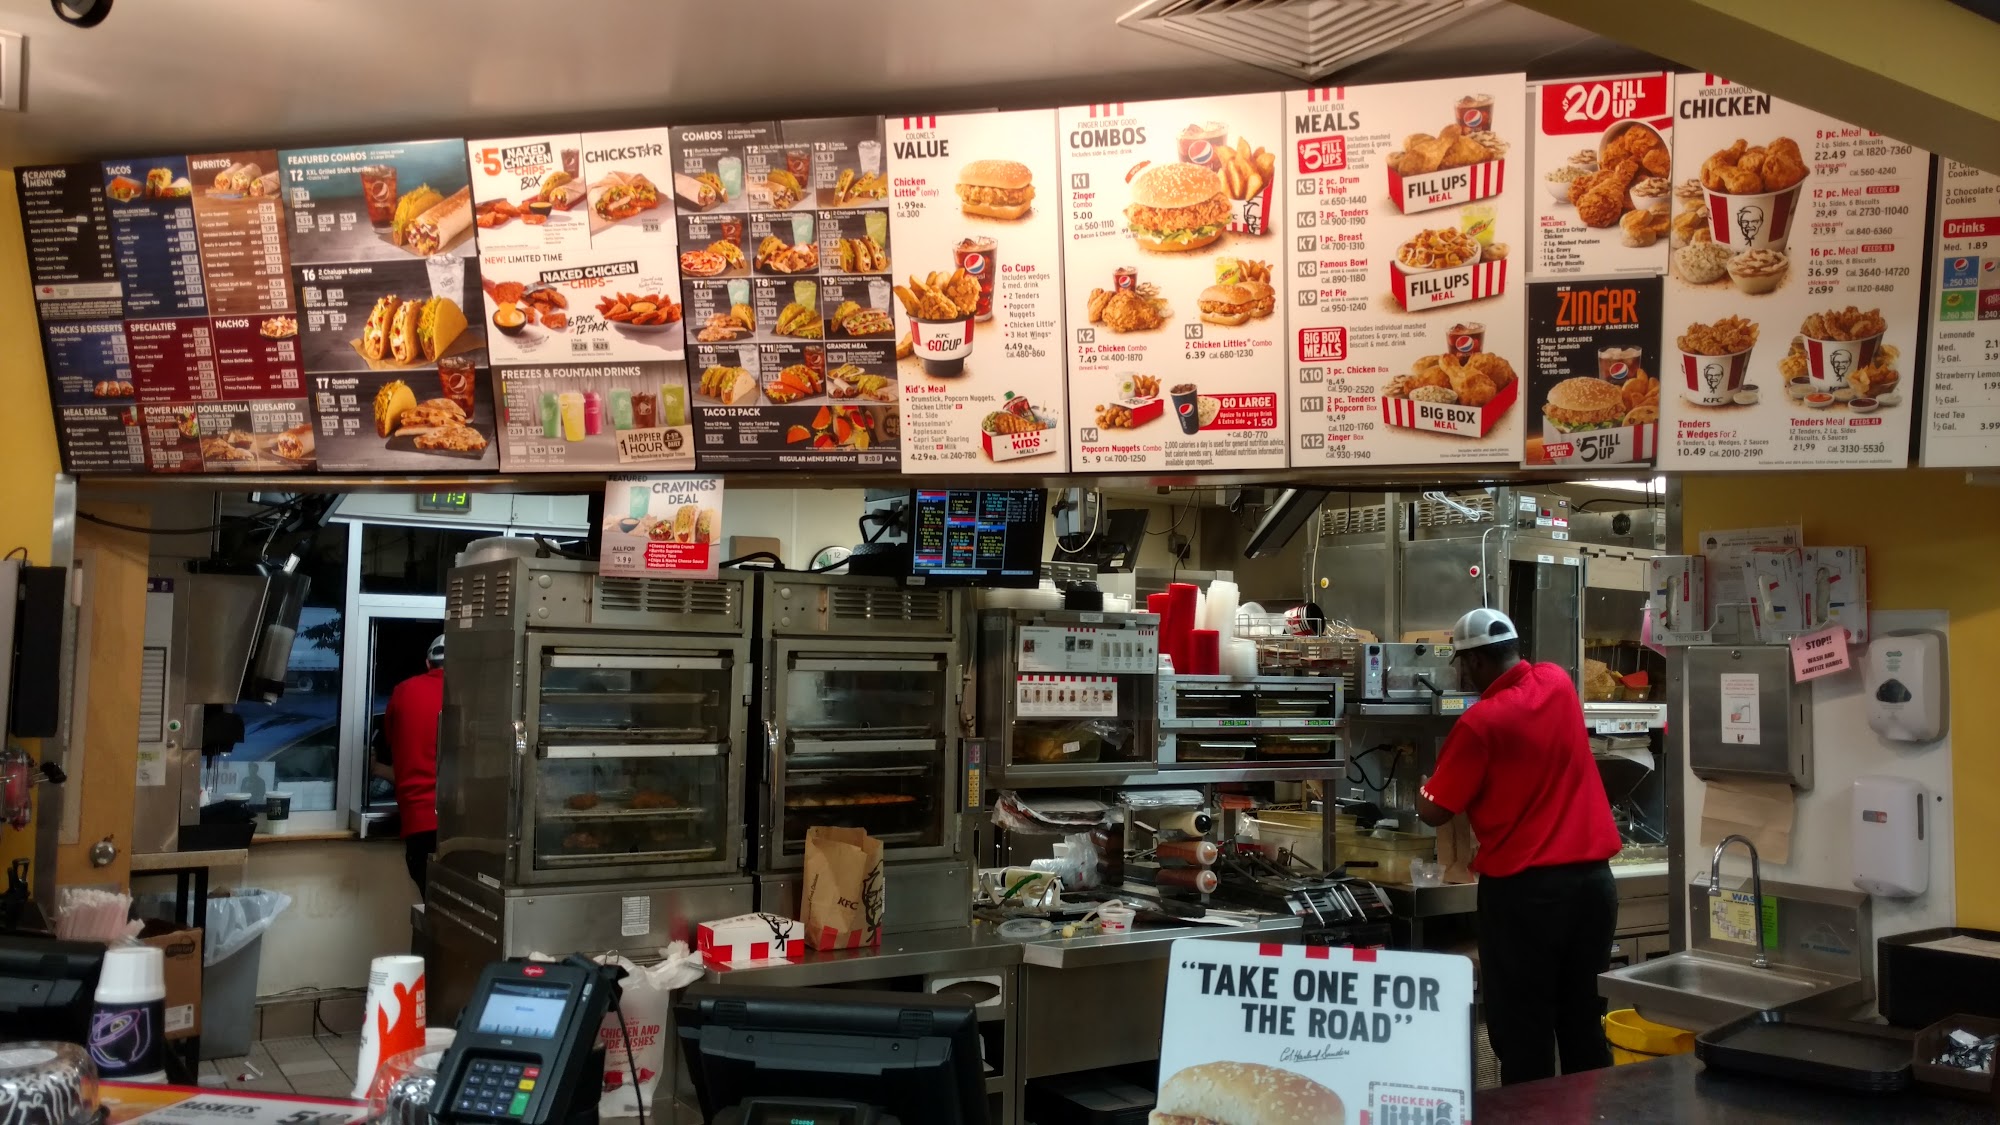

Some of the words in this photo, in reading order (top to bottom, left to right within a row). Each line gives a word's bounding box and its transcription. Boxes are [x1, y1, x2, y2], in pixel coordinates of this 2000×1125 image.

[1699, 88, 1722, 97] WORLD
[1725, 87, 1752, 95] FAMOUS
[1562, 83, 1610, 122] $20
[1612, 80, 1646, 100] FILL
[1308, 104, 1328, 113] VALUE
[1612, 100, 1637, 119] UP
[1680, 95, 1771, 119] CHICKEN
[1078, 121, 1098, 129] FINGER
[1121, 118, 1137, 126] GOOD
[1296, 111, 1360, 134] MEALS
[682, 131, 722, 141] COMBOS
[906, 132, 935, 140] COLONEL'S
[1070, 127, 1146, 149] COMBOS
[506, 145, 546, 158] NAKED
[683, 149, 692, 157] T1
[894, 140, 949, 159] VALUE
[1815, 150, 1846, 160] 22.49
[288, 155, 329, 165] FEATURED
[331, 153, 367, 162] COMBOS
[1299, 142, 1322, 170] $5
[1322, 141, 1341, 153] FILL
[1323, 152, 1341, 165] UPS
[192, 159, 231, 170] BURRITOS
[474, 148, 502, 176] $5
[504, 155, 552, 169] CHICKEN
[29, 170, 66, 179] CRAVINGS
[106, 166, 131, 175] TACOS
[290, 170, 304, 181] T2
[514, 166, 546, 176] CHIPS
[521, 175, 541, 190] BOX
[894, 178, 926, 186] Chicken
[1074, 175, 1087, 187] K1
[1408, 180, 1438, 199] FILL
[1442, 174, 1467, 191] UPS
[921, 189, 939, 197] (only)
[1073, 192, 1095, 200] Zinger
[1429, 192, 1452, 204] MEAL
[1298, 213, 1315, 226] K6
[1327, 211, 1337, 219] pc.
[1340, 209, 1368, 217] Tenders
[1948, 223, 1985, 234] Drinks
[1810, 248, 1820, 256] 16
[1823, 248, 1836, 257] pc.
[1838, 246, 1858, 255] Meal
[485, 256, 506, 264] NEW!
[508, 255, 541, 263] LIMITED
[544, 254, 563, 262] TIME
[543, 268, 583, 282] NAKED
[585, 263, 636, 278] CHICKEN
[1002, 264, 1012, 272] Go
[1015, 264, 1035, 272] Cups
[1808, 267, 1838, 277] 36.99
[302, 269, 316, 281] T6
[570, 278, 606, 289] CHIPS
[50, 325, 80, 334] SNACKS
[81, 325, 86, 333] &
[87, 324, 122, 332] DESSERTS
[130, 323, 176, 332] SPECIALTIES
[216, 319, 249, 329] NACHOS
[577, 325, 586, 335] 12
[588, 322, 609, 332] PACK
[1079, 330, 1093, 342] K2
[1186, 325, 1202, 337] K3
[1939, 331, 1975, 339] Lemonade
[1304, 332, 1319, 344] BIG
[1322, 331, 1340, 343] BOX
[698, 345, 713, 354] T10
[1085, 346, 1096, 354] pc.
[1304, 344, 1342, 358] MEALS
[1185, 351, 1206, 360] 6.39
[502, 369, 541, 379] FREEZES
[544, 369, 551, 378] &
[553, 368, 602, 378] FOUNTAIN
[604, 367, 641, 376] DRINKS
[1301, 370, 1322, 381] K10
[316, 378, 329, 389] T7
[905, 385, 925, 393] Kid's
[928, 385, 946, 393] Meal
[253, 403, 295, 411] QUESARITO
[1222, 399, 1237, 408] GO
[1239, 397, 1271, 407] LARGE
[64, 408, 82, 416] MEAL
[84, 407, 107, 415] DEALS
[144, 407, 170, 415] POWER
[172, 406, 195, 414] MENU
[197, 404, 249, 413] DOUBLEDILLA
[703, 408, 726, 417] TACO
[738, 408, 760, 416] PACK
[1421, 406, 1444, 421] BIG
[1447, 409, 1475, 424] BOX
[1434, 420, 1458, 431] MEAL
[1678, 420, 1711, 428] Tenders
[628, 433, 661, 442] HAPPIER
[1083, 430, 1097, 441] K4
[630, 442, 662, 453] HOUR
[1012, 438, 1040, 450] KIDS
[1082, 445, 1110, 453] Popcorn
[1112, 444, 1140, 452] Nuggets
[1143, 444, 1162, 452] Combo
[1678, 448, 1706, 456] 10.49
[653, 480, 716, 494] CRAVINGS
[669, 494, 698, 505] DEAL
[1806, 636, 1832, 650] STOP!!
[1807, 654, 1823, 664] WASH
[1824, 652, 1835, 660] AND
[1802, 663, 1825, 675] SANITIZE
[1826, 658, 1843, 670] HANDS
[1732, 893, 1755, 902] WAS
[837, 897, 859, 911] KFC
[1293, 968, 1358, 1006] ONE
[1373, 973, 1440, 1013] FOR
[1241, 1002, 1296, 1037] THE
[601, 1026, 638, 1038] CHICEN
[641, 1025, 660, 1036] AND
[1381, 1094, 1433, 1107] CHICKEN
